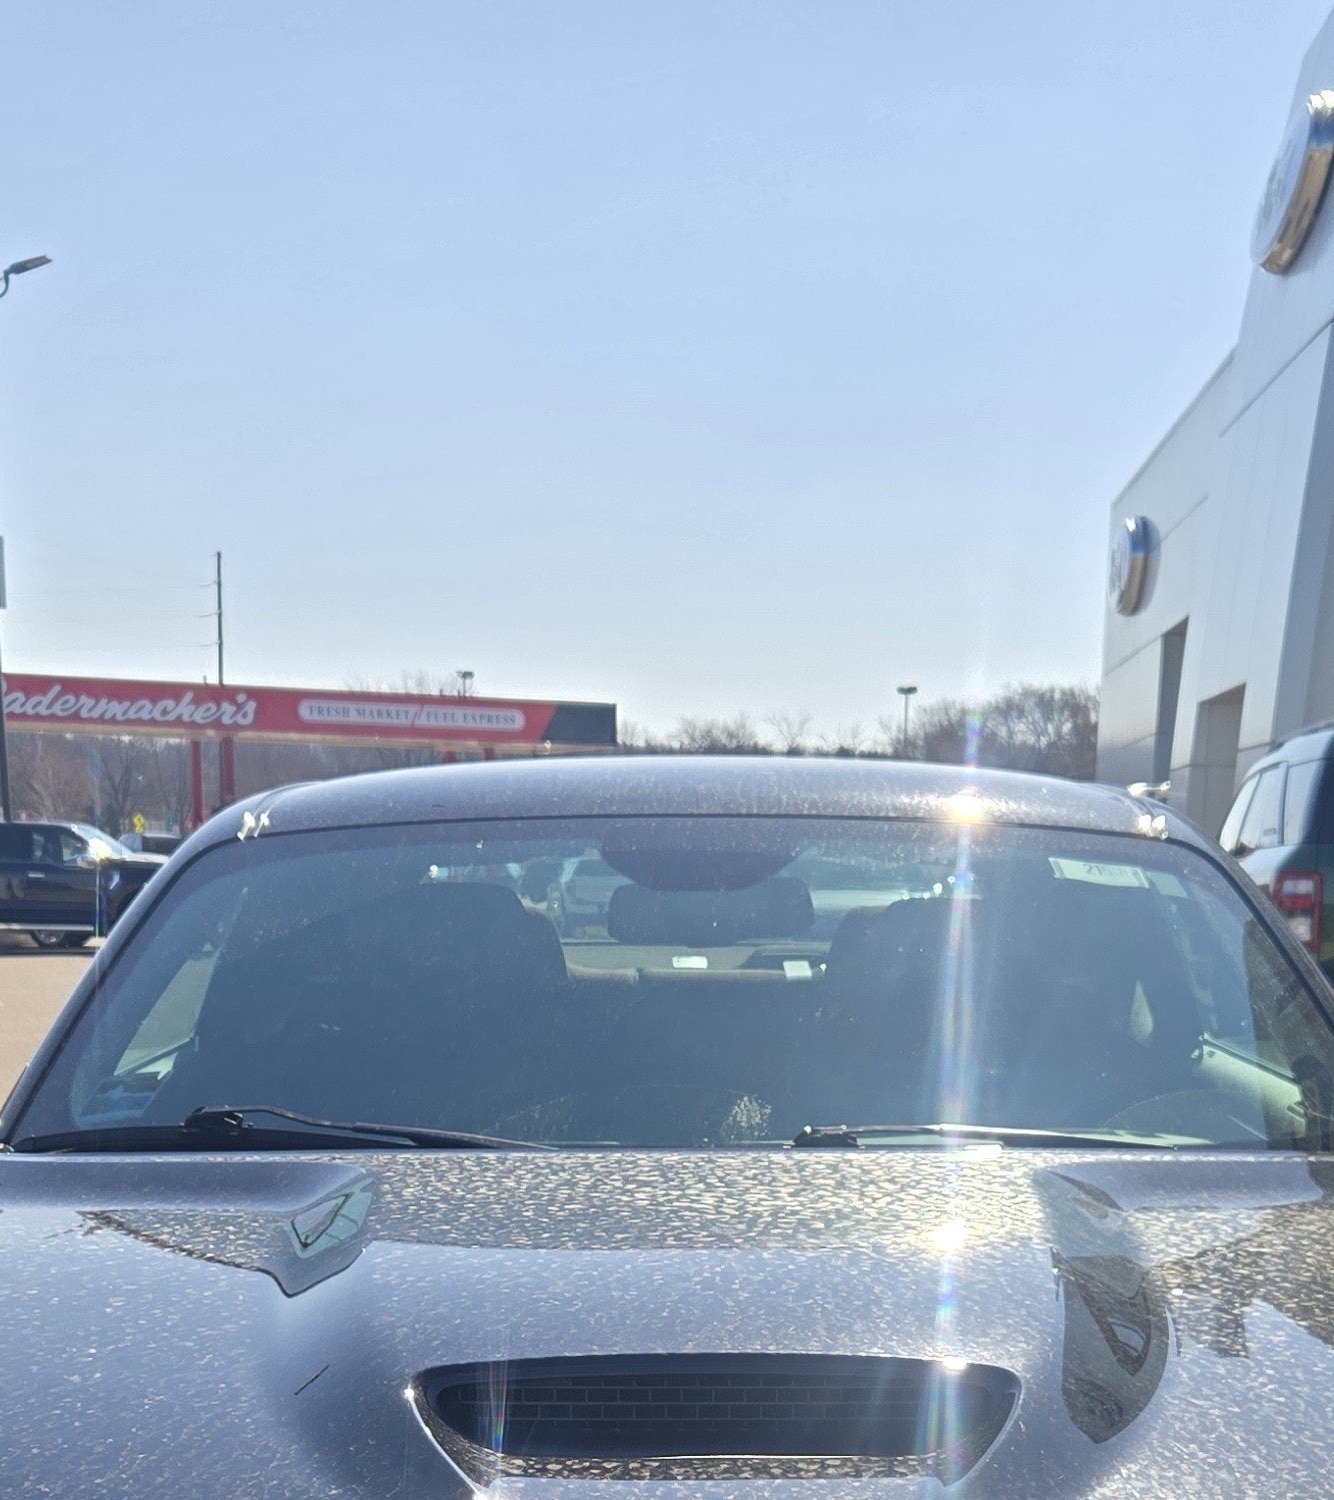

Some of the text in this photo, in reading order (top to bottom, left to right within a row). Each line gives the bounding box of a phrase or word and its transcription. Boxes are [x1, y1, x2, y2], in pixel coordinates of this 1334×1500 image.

[309, 706, 517, 726] FRESH MARKET FUEL EXPRESS
